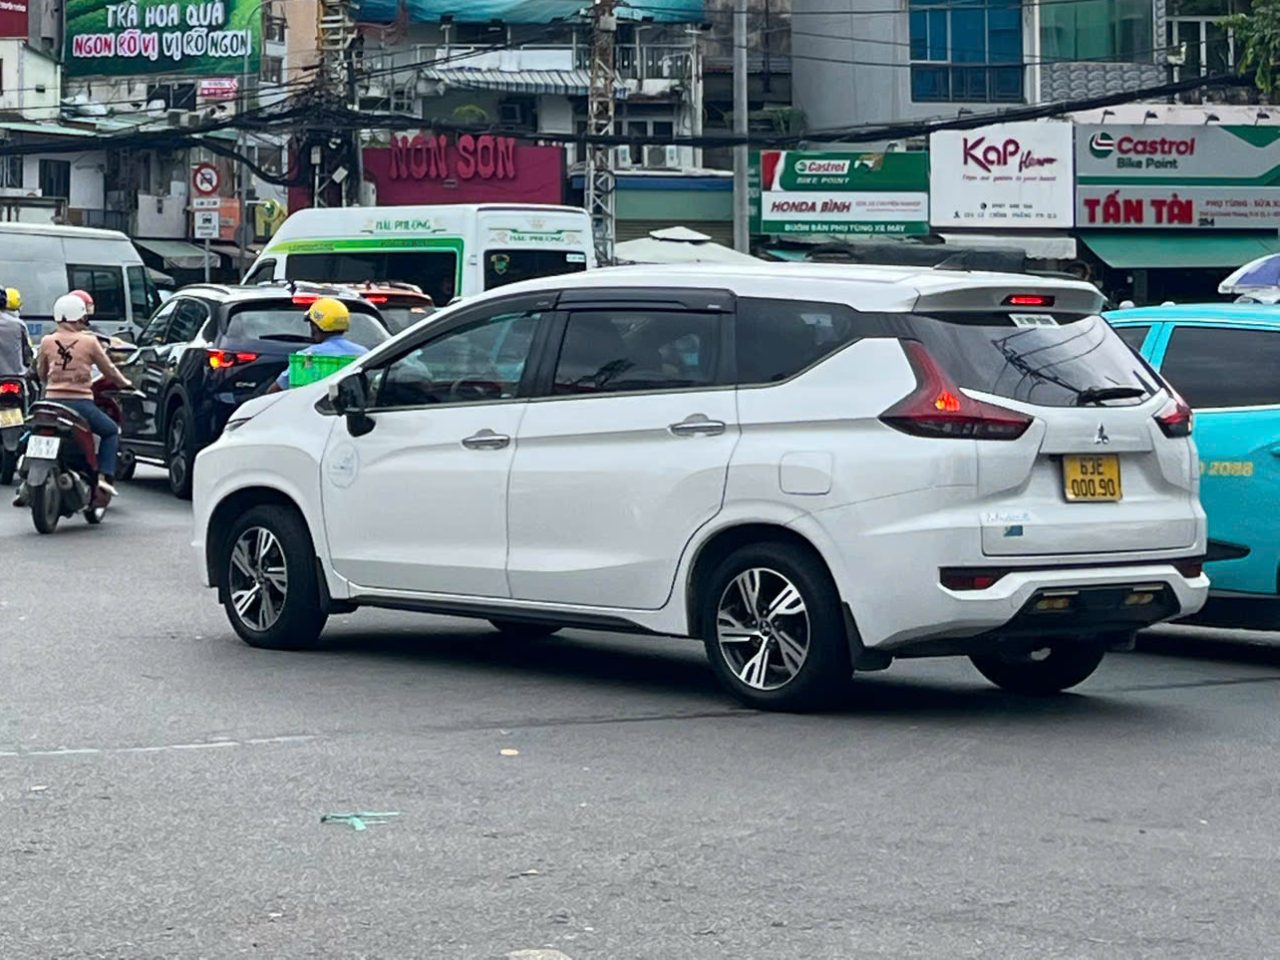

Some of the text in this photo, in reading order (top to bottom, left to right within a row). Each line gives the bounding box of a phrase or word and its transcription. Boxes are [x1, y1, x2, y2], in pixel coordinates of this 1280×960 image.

[145, 3, 180, 27] HOA
[73, 28, 251, 60] NGON RÕ VỊ VỊ RÕ NGON
[1117, 136, 1195, 156] Castrol
[808, 161, 846, 172] Castrol
[1117, 157, 1178, 169] Bike Point
[771, 198, 851, 213] HONDA BÌNH
[1084, 190, 1194, 225] TẤN TÀI
[1079, 457, 1104, 476] 63E
[1071, 478, 1116, 497] 000.90
